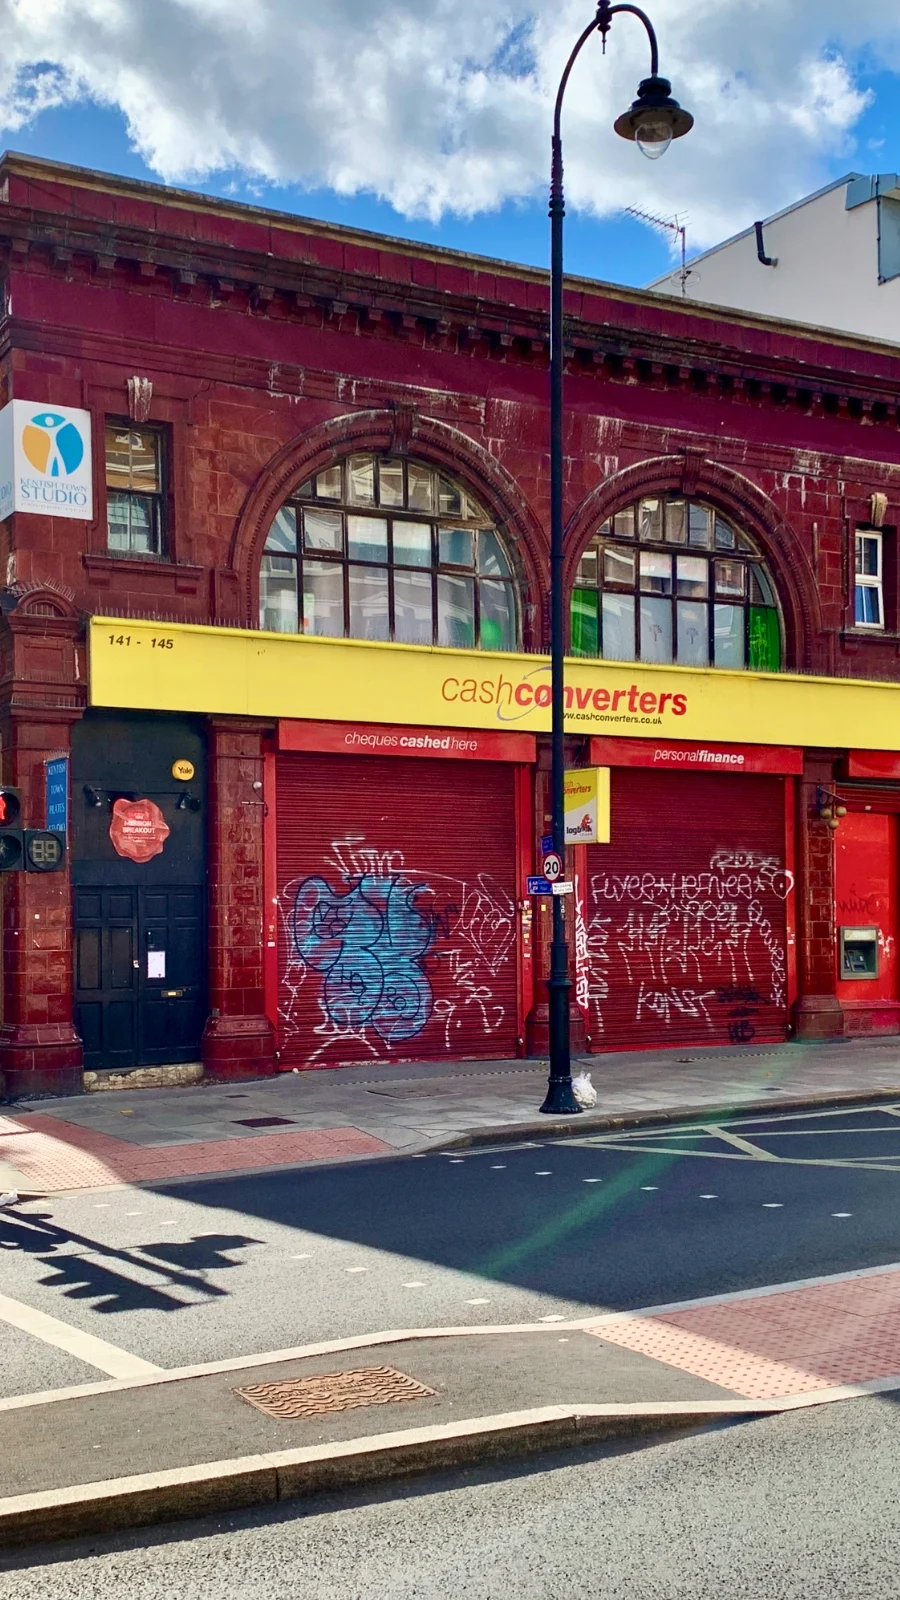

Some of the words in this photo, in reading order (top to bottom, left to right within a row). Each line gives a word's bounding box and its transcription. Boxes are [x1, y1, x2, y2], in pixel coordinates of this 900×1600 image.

[20, 477, 58, 489] KENTISH
[60, 482, 87, 493] TOWN
[21, 484, 88, 506] STUDIO
[108, 634, 131, 647] 141
[151, 637, 174, 650] 145
[344, 731, 399, 749] cheques
[400, 735, 451, 750] cashed
[451, 737, 478, 751] here
[177, 766, 193, 775] Yale
[50, 783, 64, 795] TOWN
[545, 862, 559, 874] 20
